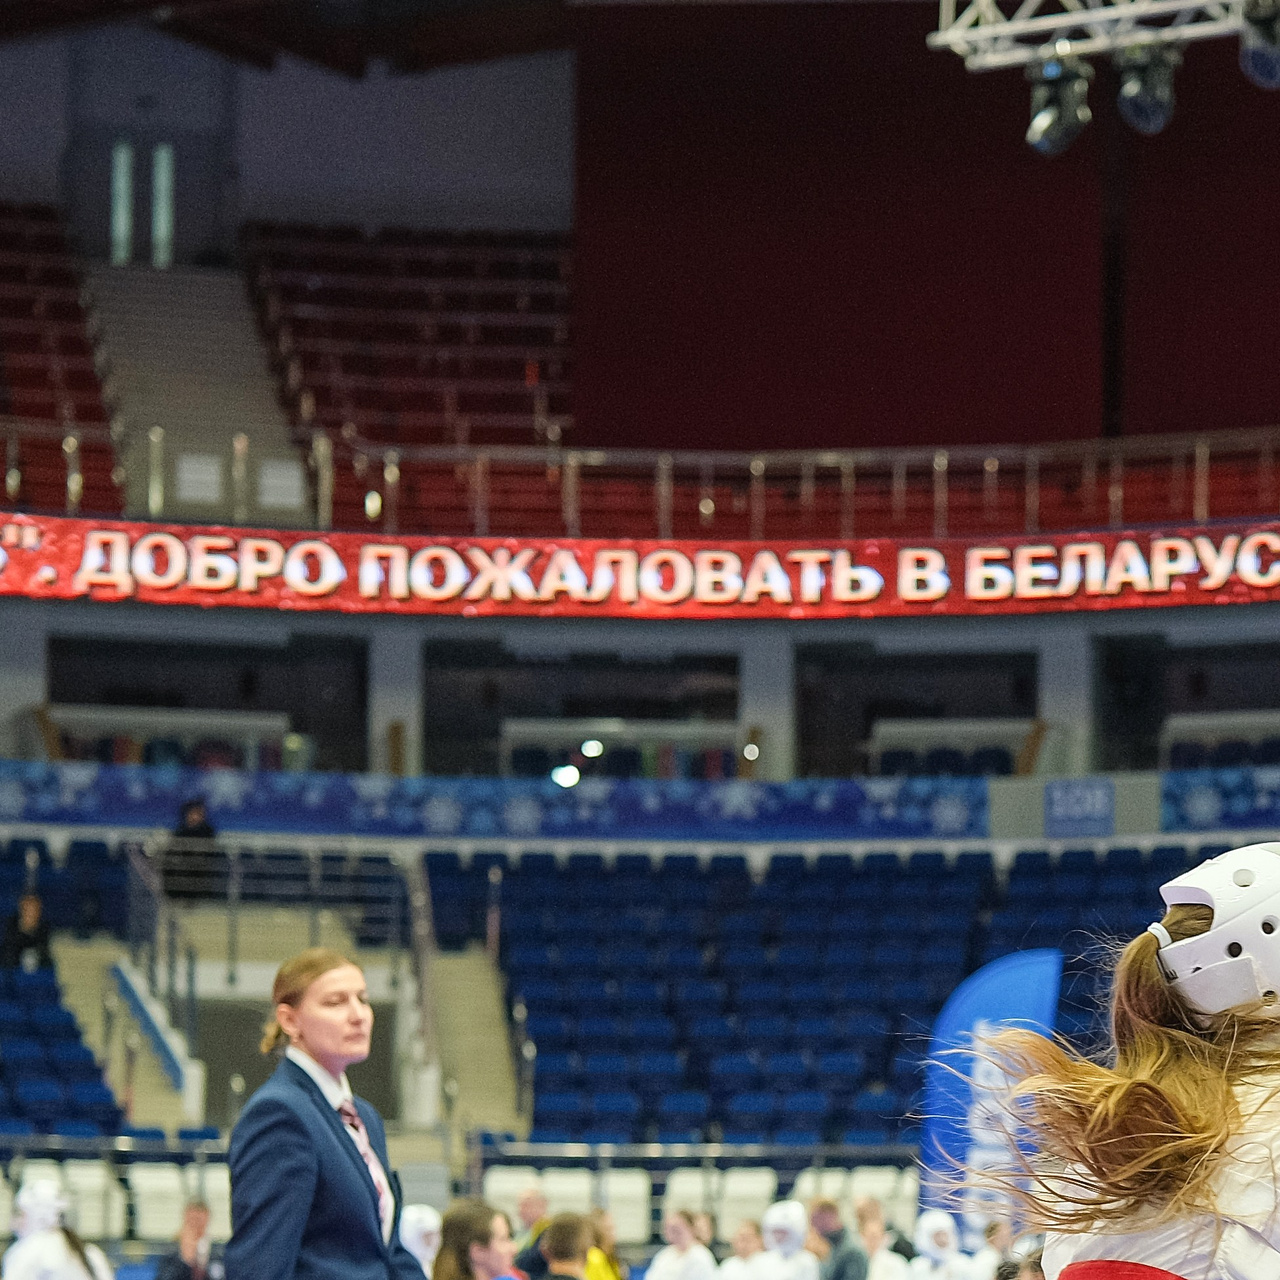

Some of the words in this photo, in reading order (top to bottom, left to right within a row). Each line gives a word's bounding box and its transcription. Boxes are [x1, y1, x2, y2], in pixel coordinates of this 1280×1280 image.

[73, 530, 346, 596] ДОБРО
[358, 543, 884, 604] ПОЖАЛОВАТЬ
[897, 547, 951, 602] В
